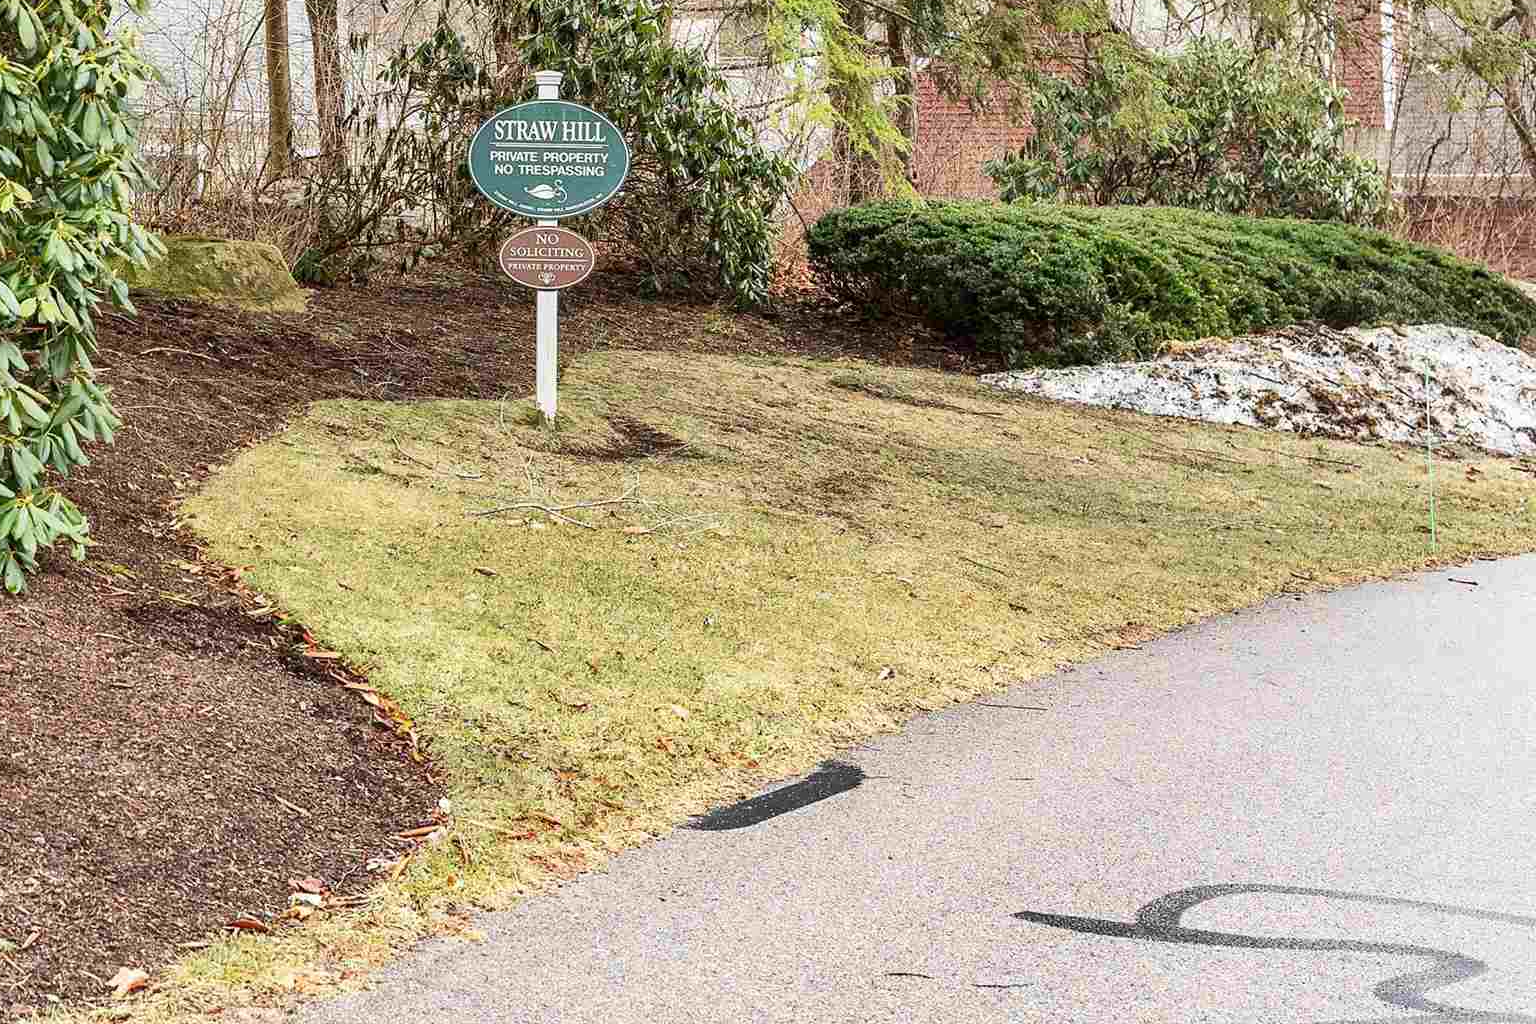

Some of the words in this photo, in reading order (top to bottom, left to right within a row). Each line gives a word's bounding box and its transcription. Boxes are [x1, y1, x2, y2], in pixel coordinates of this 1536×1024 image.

[494, 120, 557, 141] STRAW
[563, 122, 607, 142] HILL
[490, 151, 537, 162] PRIVATE
[544, 152, 609, 164] PROPERTY
[495, 165, 513, 175] NO
[519, 165, 605, 177] TRESPASSING
[535, 233, 560, 245] NO
[510, 247, 585, 258] SOLICITING
[507, 263, 542, 272] PRIVATE
[543, 263, 586, 272] PROPERTY
